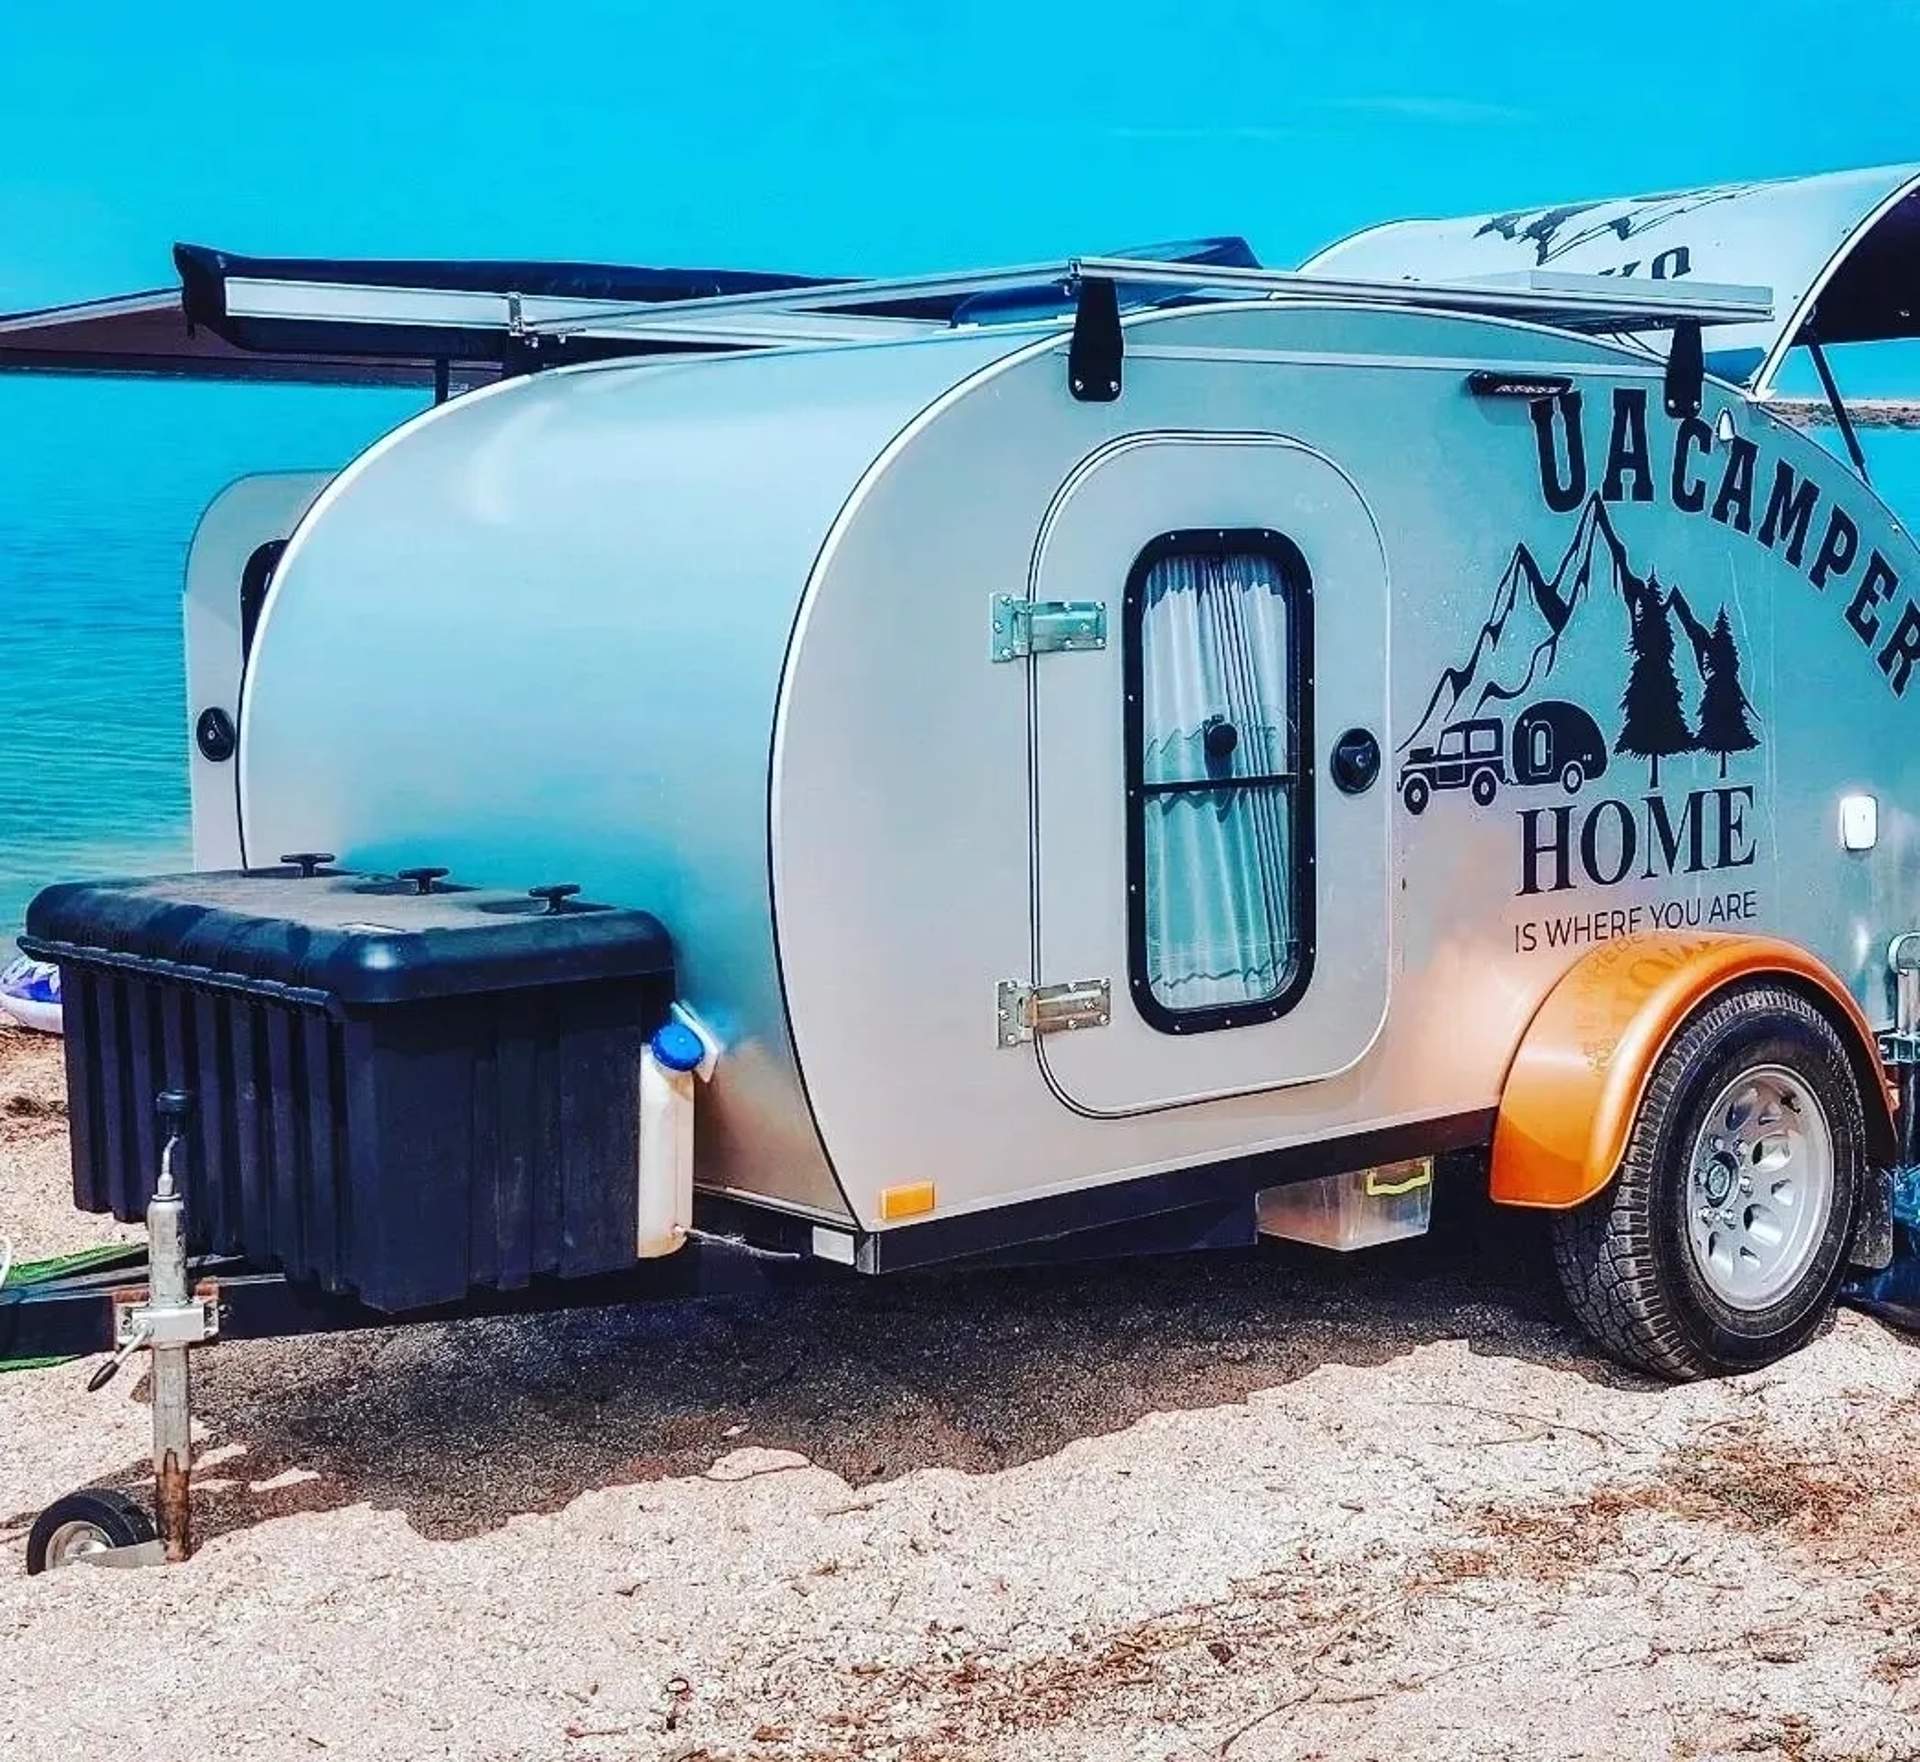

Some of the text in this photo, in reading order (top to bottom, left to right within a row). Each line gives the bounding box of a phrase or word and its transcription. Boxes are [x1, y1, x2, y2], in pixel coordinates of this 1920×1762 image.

[1515, 785, 1757, 897] HOME
[1514, 890, 1757, 954] IS WHERE YOU ARE
